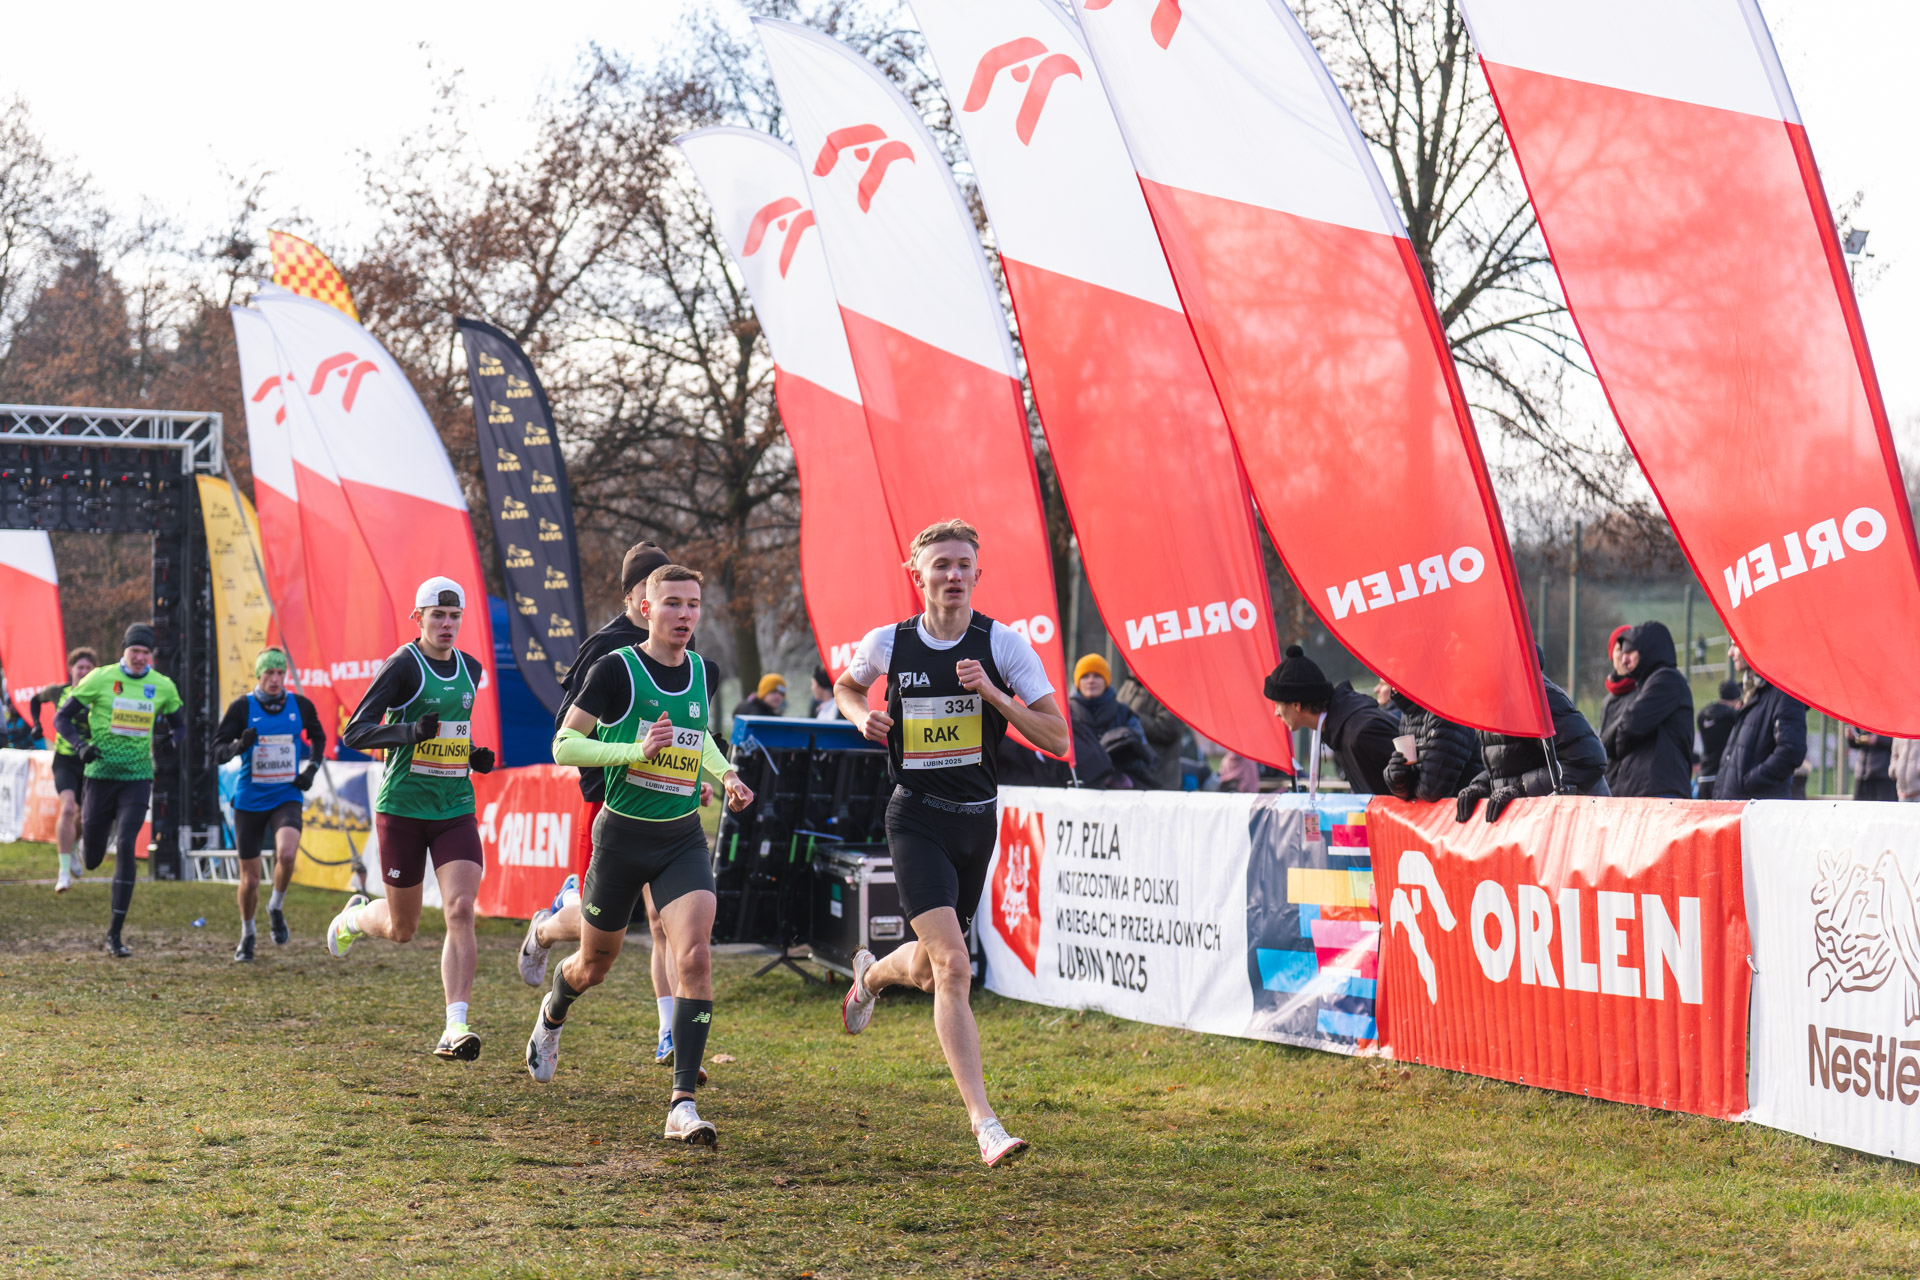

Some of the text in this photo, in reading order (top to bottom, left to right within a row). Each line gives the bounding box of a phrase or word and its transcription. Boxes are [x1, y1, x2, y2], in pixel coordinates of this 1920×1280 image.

[944, 698, 975, 714] 334
[455, 724, 467, 736] 98
[923, 725, 960, 743] RAK
[677, 732, 700, 746] 637
[280, 746, 290, 755] 50
[416, 742, 468, 758] KITLIŃSKI
[255, 759, 293, 771] SKIBIAK
[923, 757, 962, 768] LUBIN 2025
[645, 781, 680, 793] LUBIN 2025
[922, 795, 959, 813] NIKE
[498, 811, 571, 868] ORLEN
[1056, 819, 1121, 861] 97. PZLA
[1133, 877, 1179, 906] POLSKI
[1066, 908, 1116, 940] BIEGACH
[1120, 914, 1222, 952] PRZEŁAJOWYCH
[1470, 879, 1703, 1005] ORLEN
[1057, 942, 1148, 993] LUBIN 2025
